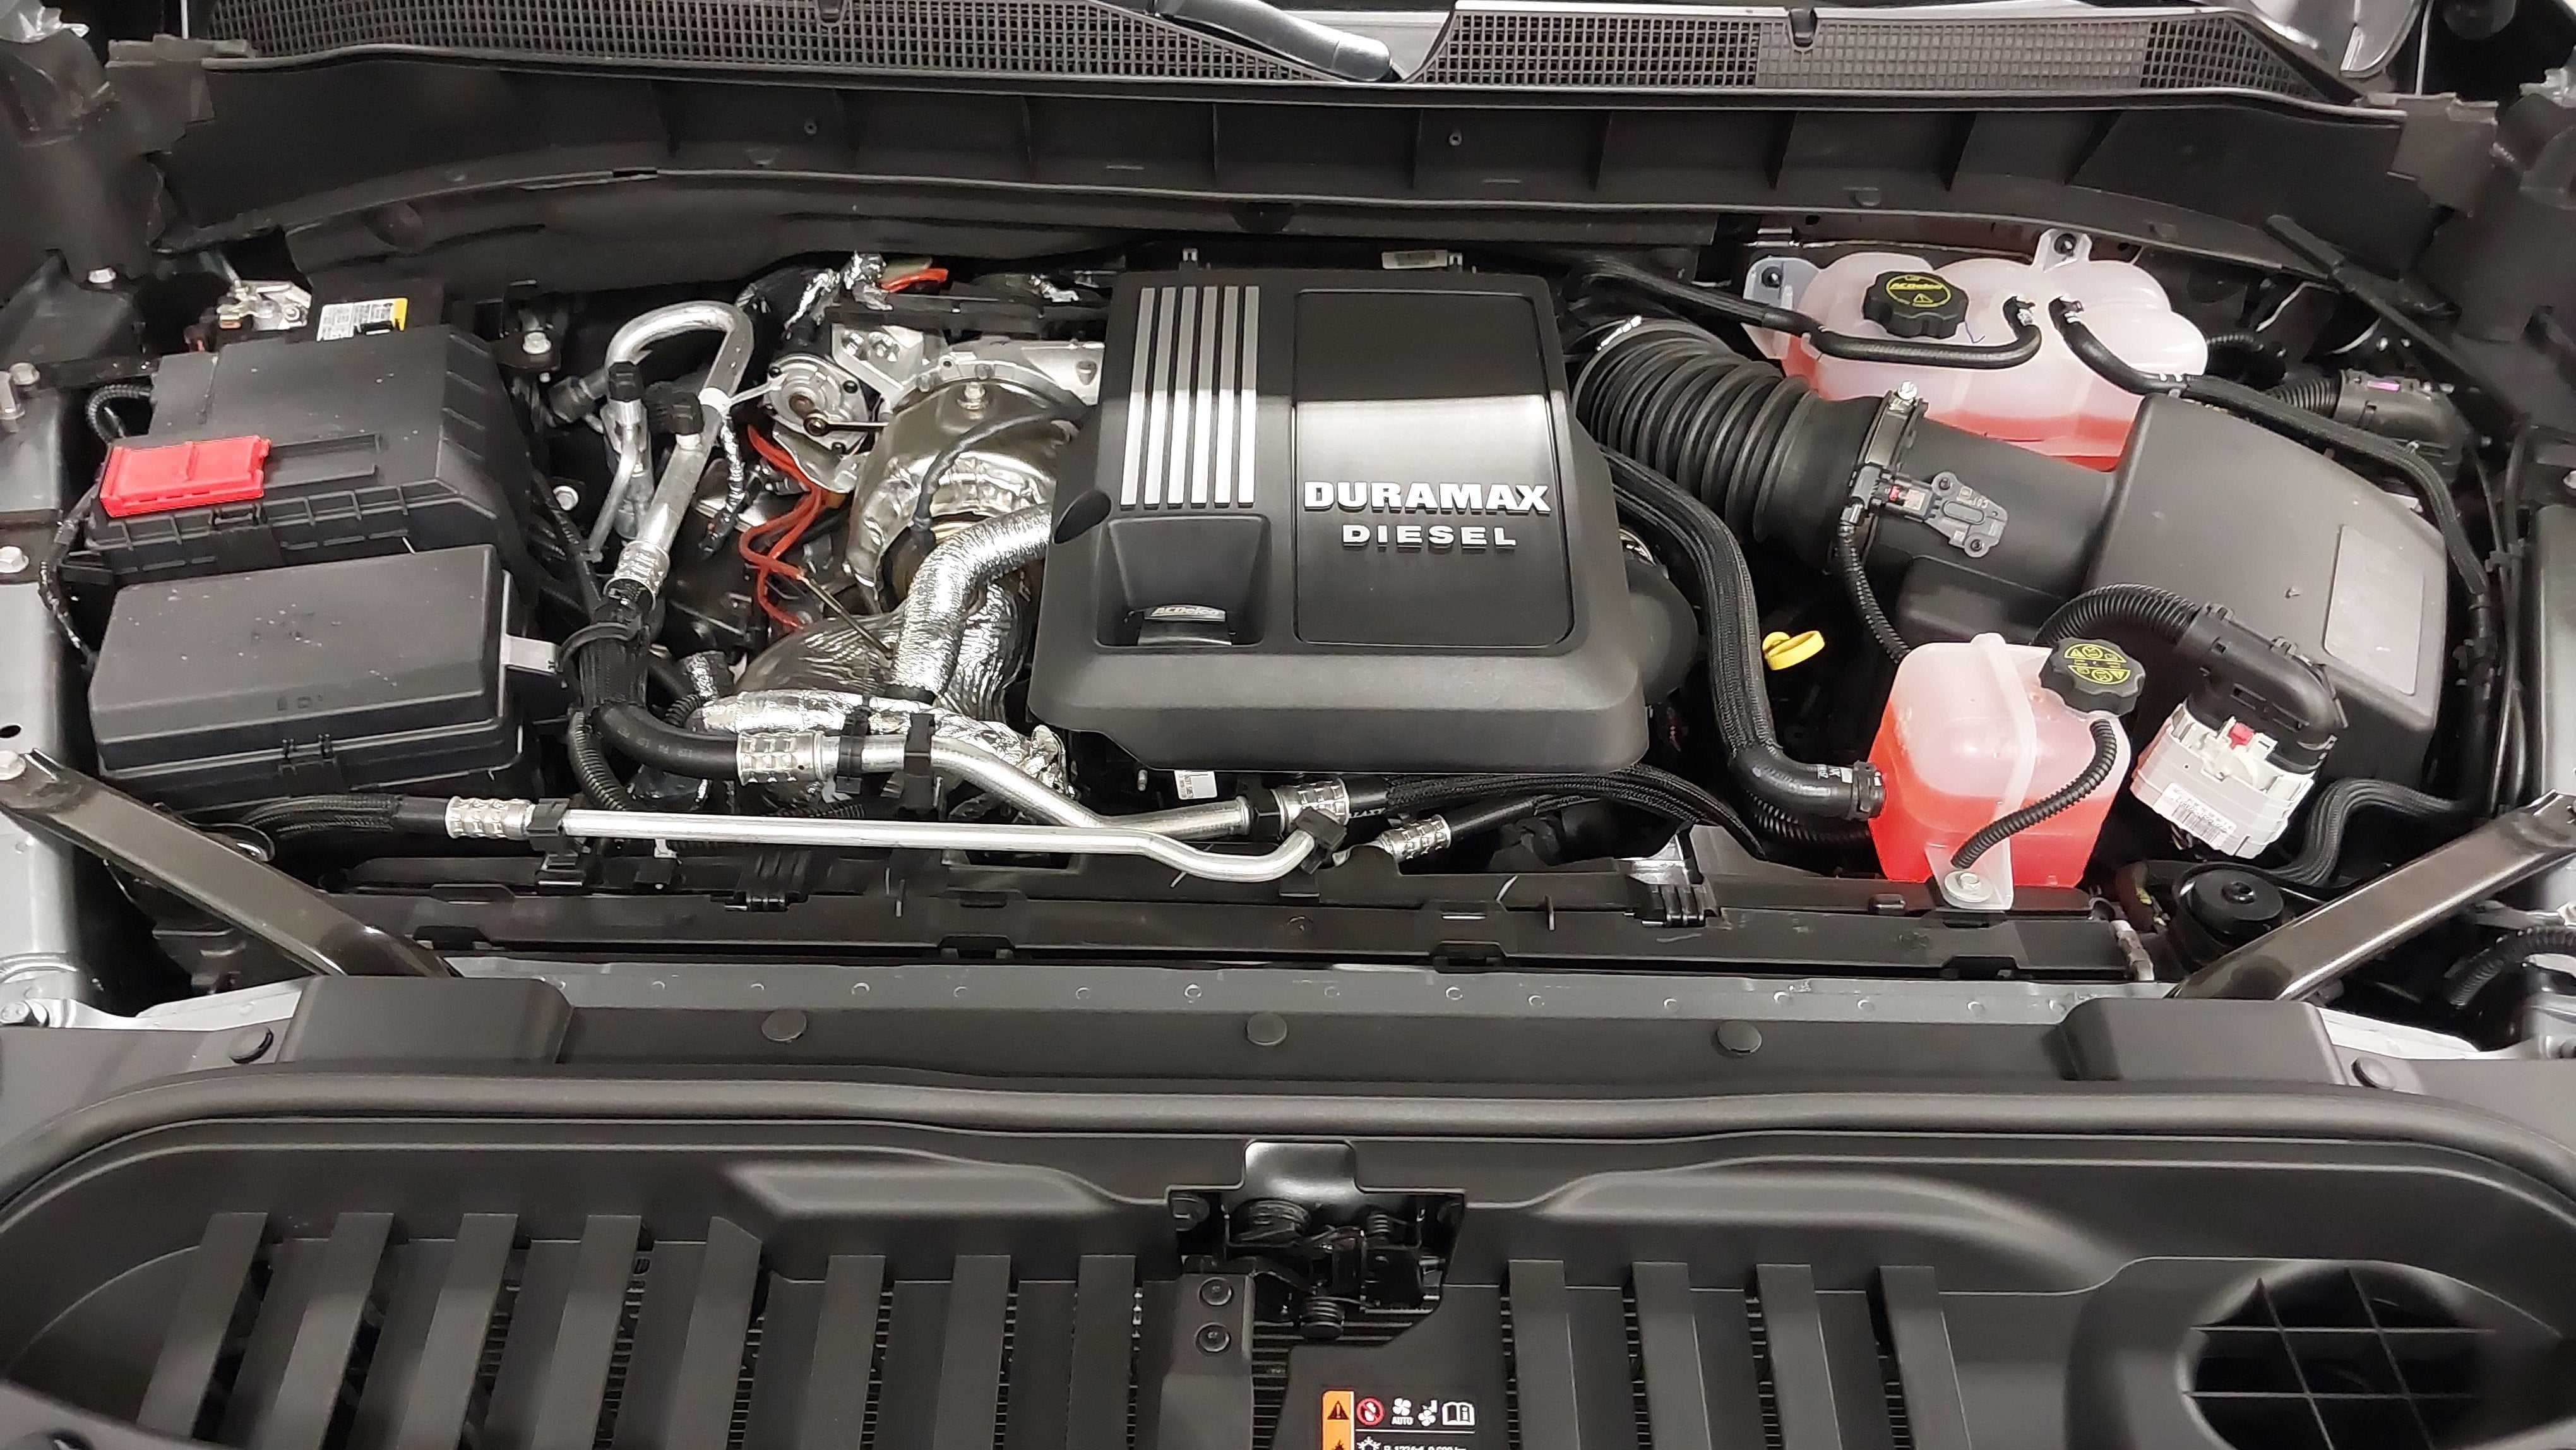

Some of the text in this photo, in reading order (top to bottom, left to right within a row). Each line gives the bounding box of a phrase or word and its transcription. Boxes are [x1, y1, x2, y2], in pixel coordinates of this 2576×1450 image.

[1304, 481, 1552, 514] DURAMAX
[1342, 524, 1517, 547] DIESEL
[1392, 1417, 1413, 1425] AUTO
